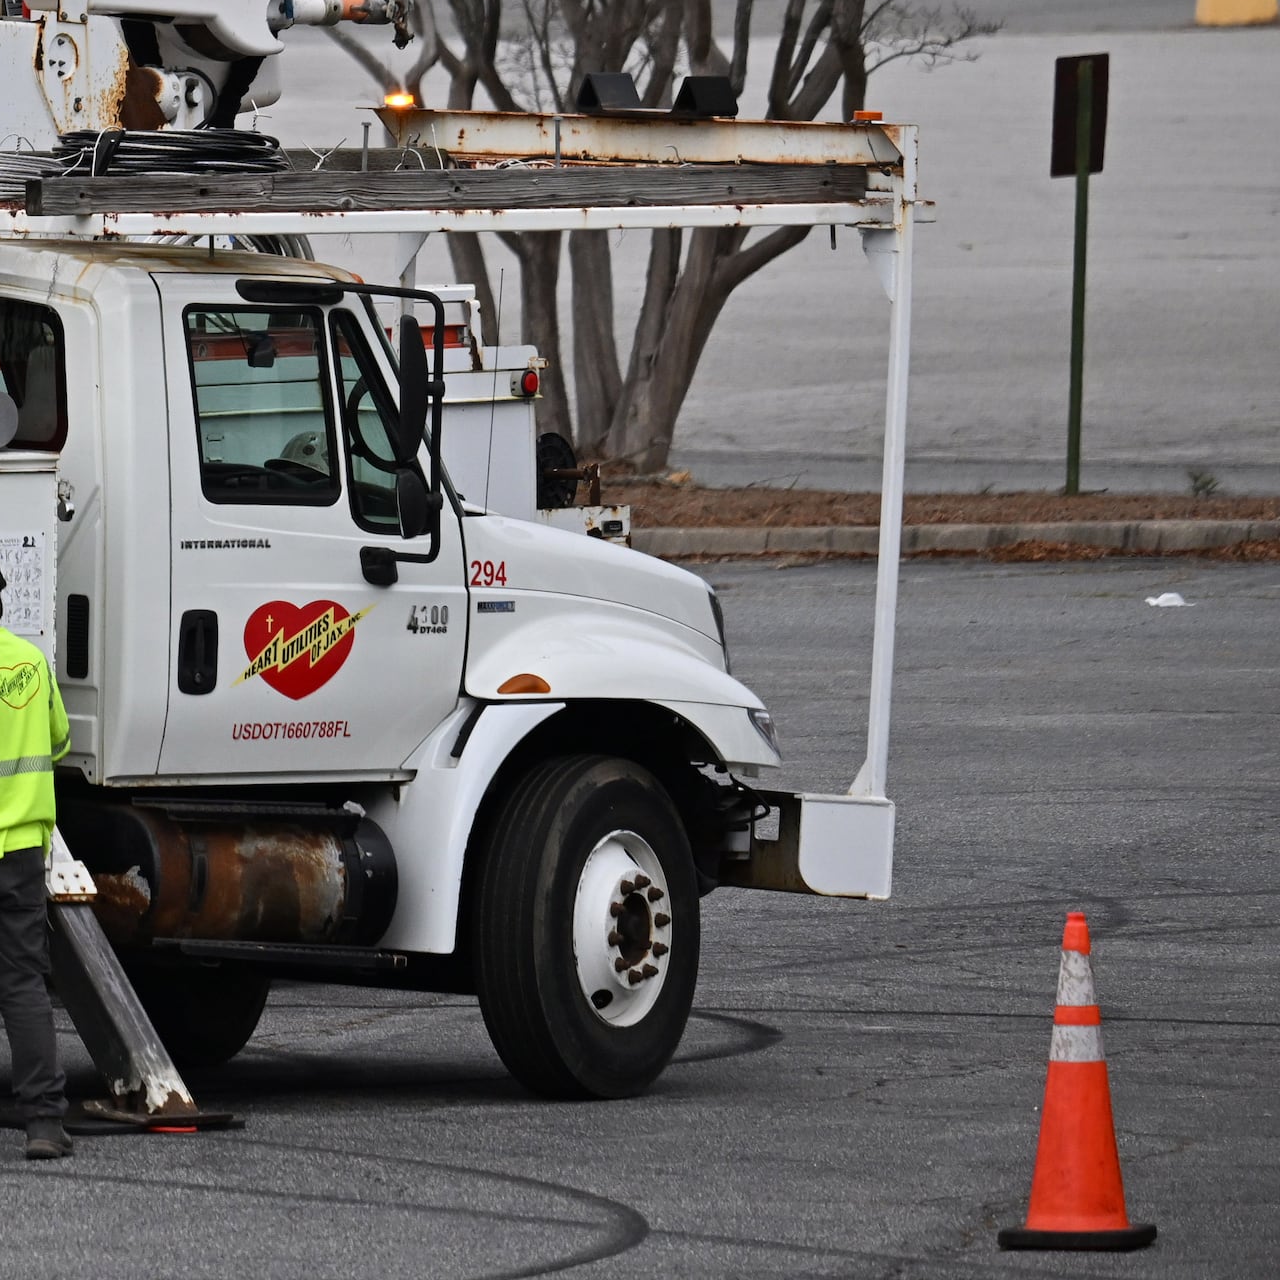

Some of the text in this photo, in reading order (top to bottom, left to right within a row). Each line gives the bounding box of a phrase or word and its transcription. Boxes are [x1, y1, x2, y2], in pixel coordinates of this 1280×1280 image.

[180, 538, 272, 550] INTERNATIONAL
[470, 560, 507, 586] 294
[419, 626, 448, 634] DT466
[244, 613, 330, 680] HEART UTILITIES
[311, 640, 322, 663] OF
[232, 721, 351, 740] USDOT1660788FL
